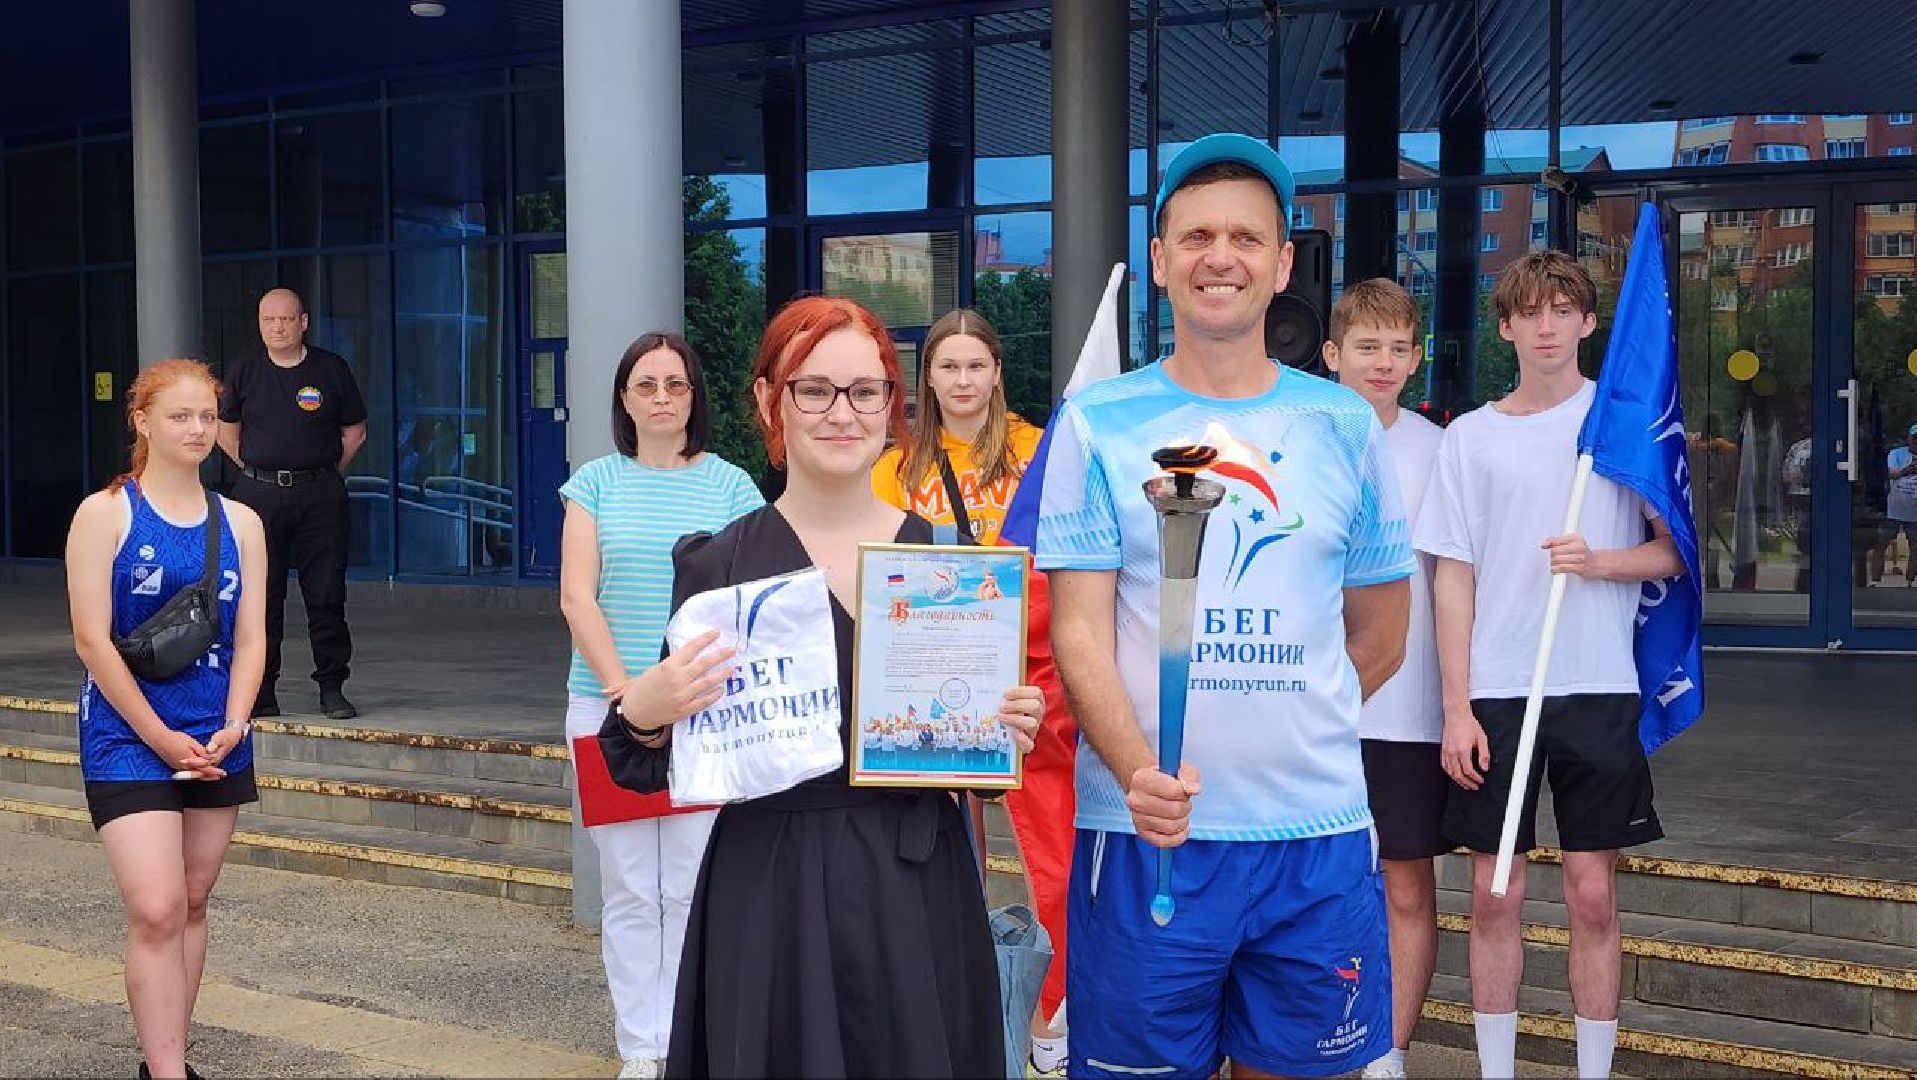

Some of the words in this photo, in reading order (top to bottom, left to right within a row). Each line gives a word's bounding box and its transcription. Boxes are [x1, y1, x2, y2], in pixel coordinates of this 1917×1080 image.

[906, 460, 1028, 519] MAV
[1203, 607, 1281, 636] БЕГ
[1190, 641, 1305, 665] РМОНИИ
[726, 655, 794, 697] БЕГ
[1189, 676, 1306, 696] rmonyrun.ru
[1335, 1019, 1358, 1036] БЕГ
